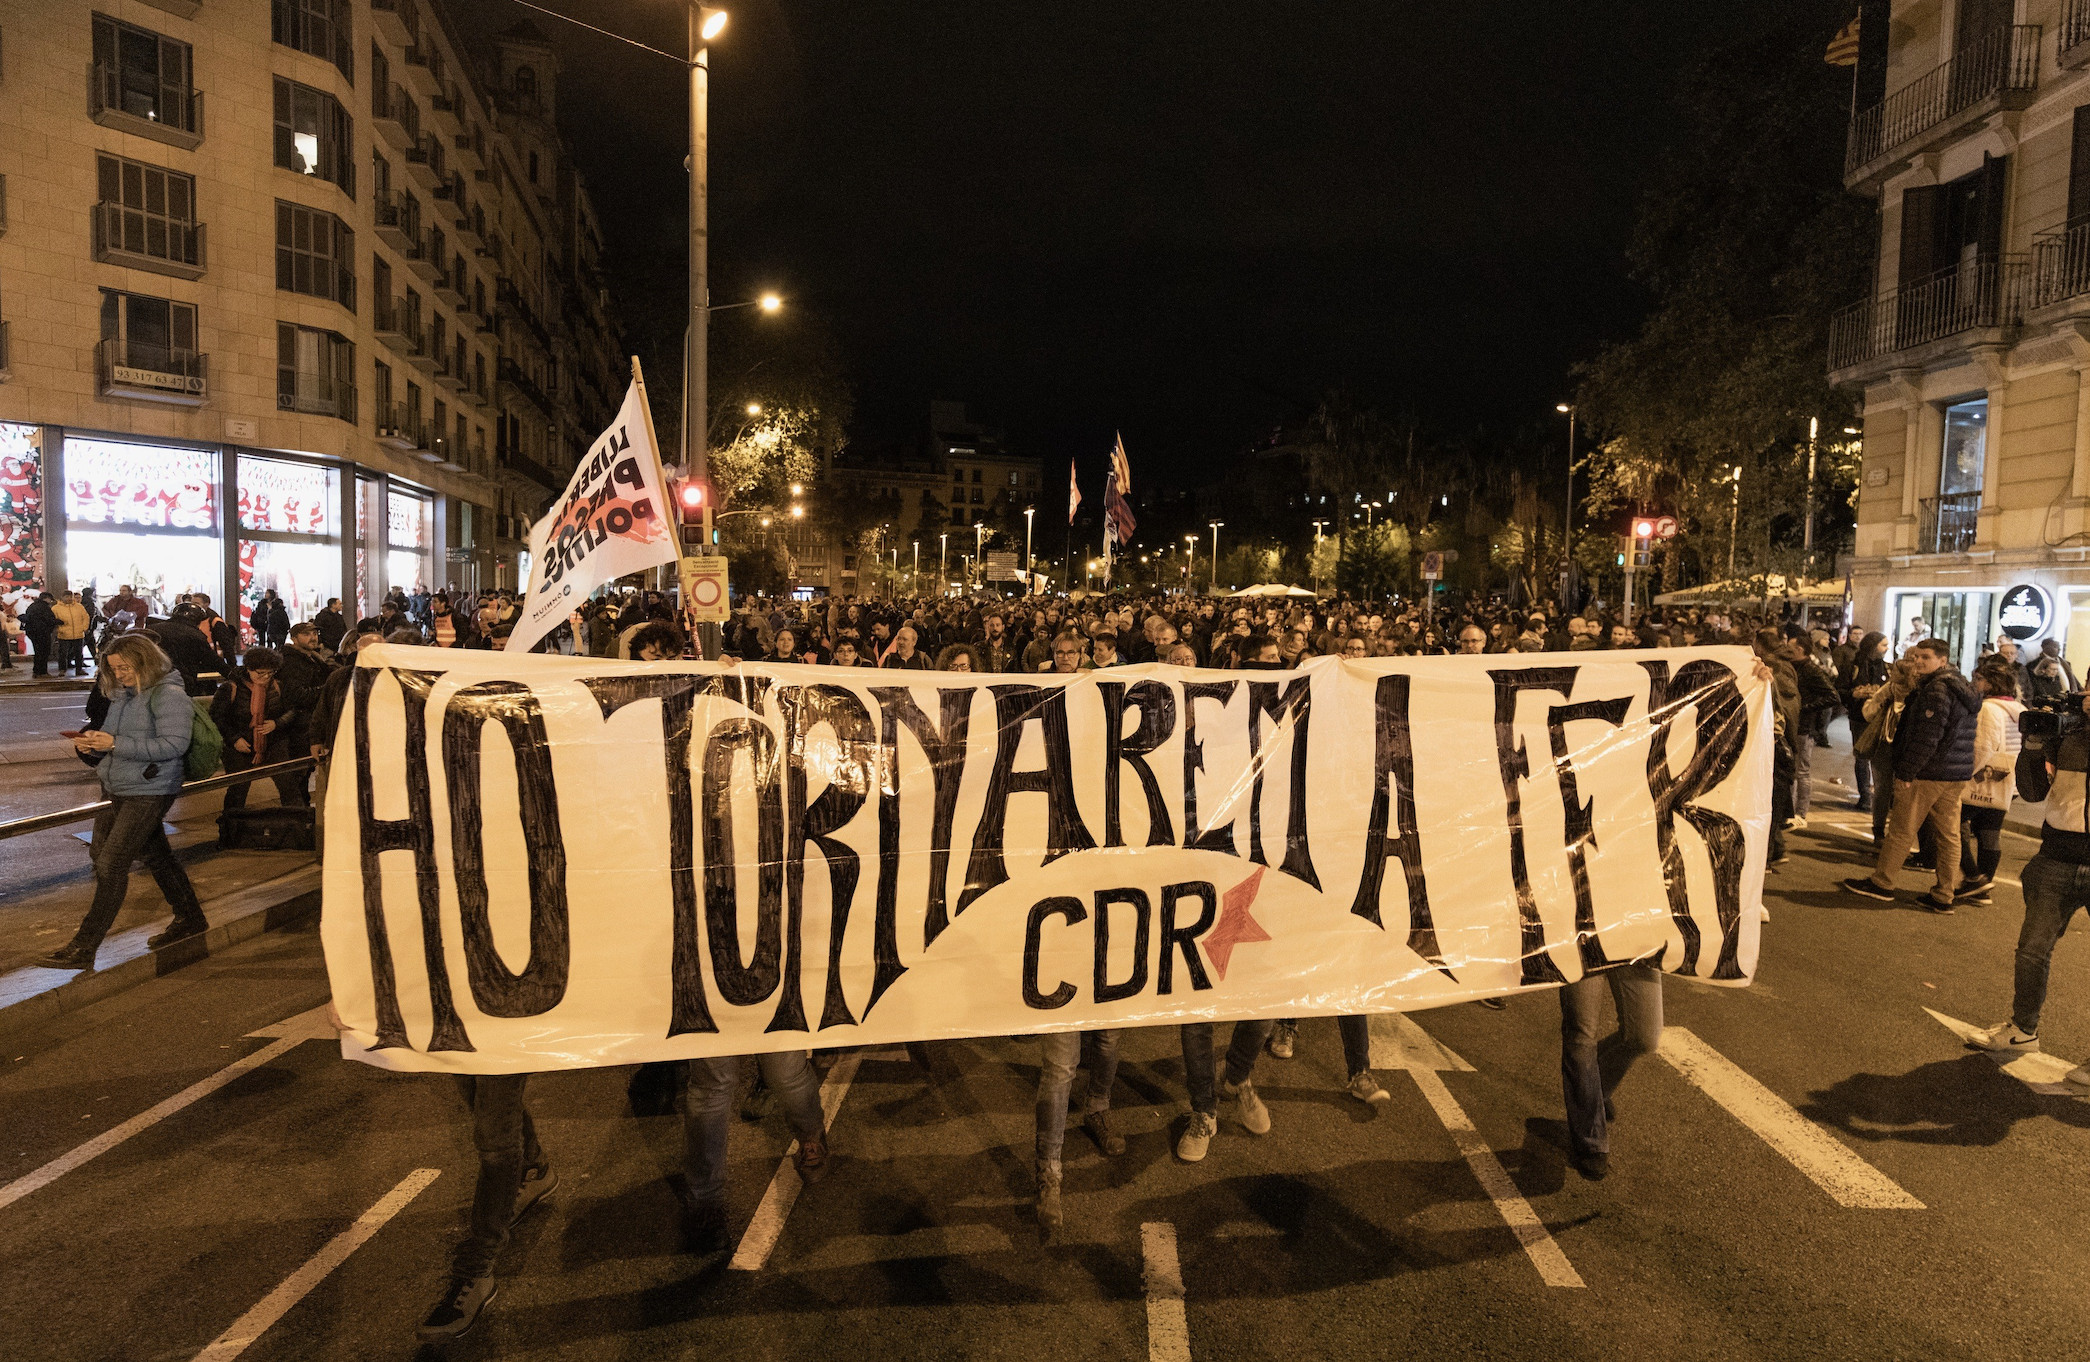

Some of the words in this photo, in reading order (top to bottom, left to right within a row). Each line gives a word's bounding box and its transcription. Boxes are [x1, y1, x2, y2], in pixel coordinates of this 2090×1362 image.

[117, 369, 130, 378] 93
[133, 372, 152, 381] 317
[155, 375, 167, 384] 63
[170, 377, 183, 386] 47
[353, 667, 570, 1053] HO
[574, 674, 1323, 1039] TORNAREM
[1351, 674, 1460, 984] A
[1486, 659, 1748, 986] FER
[1022, 881, 1217, 1010] CDR
